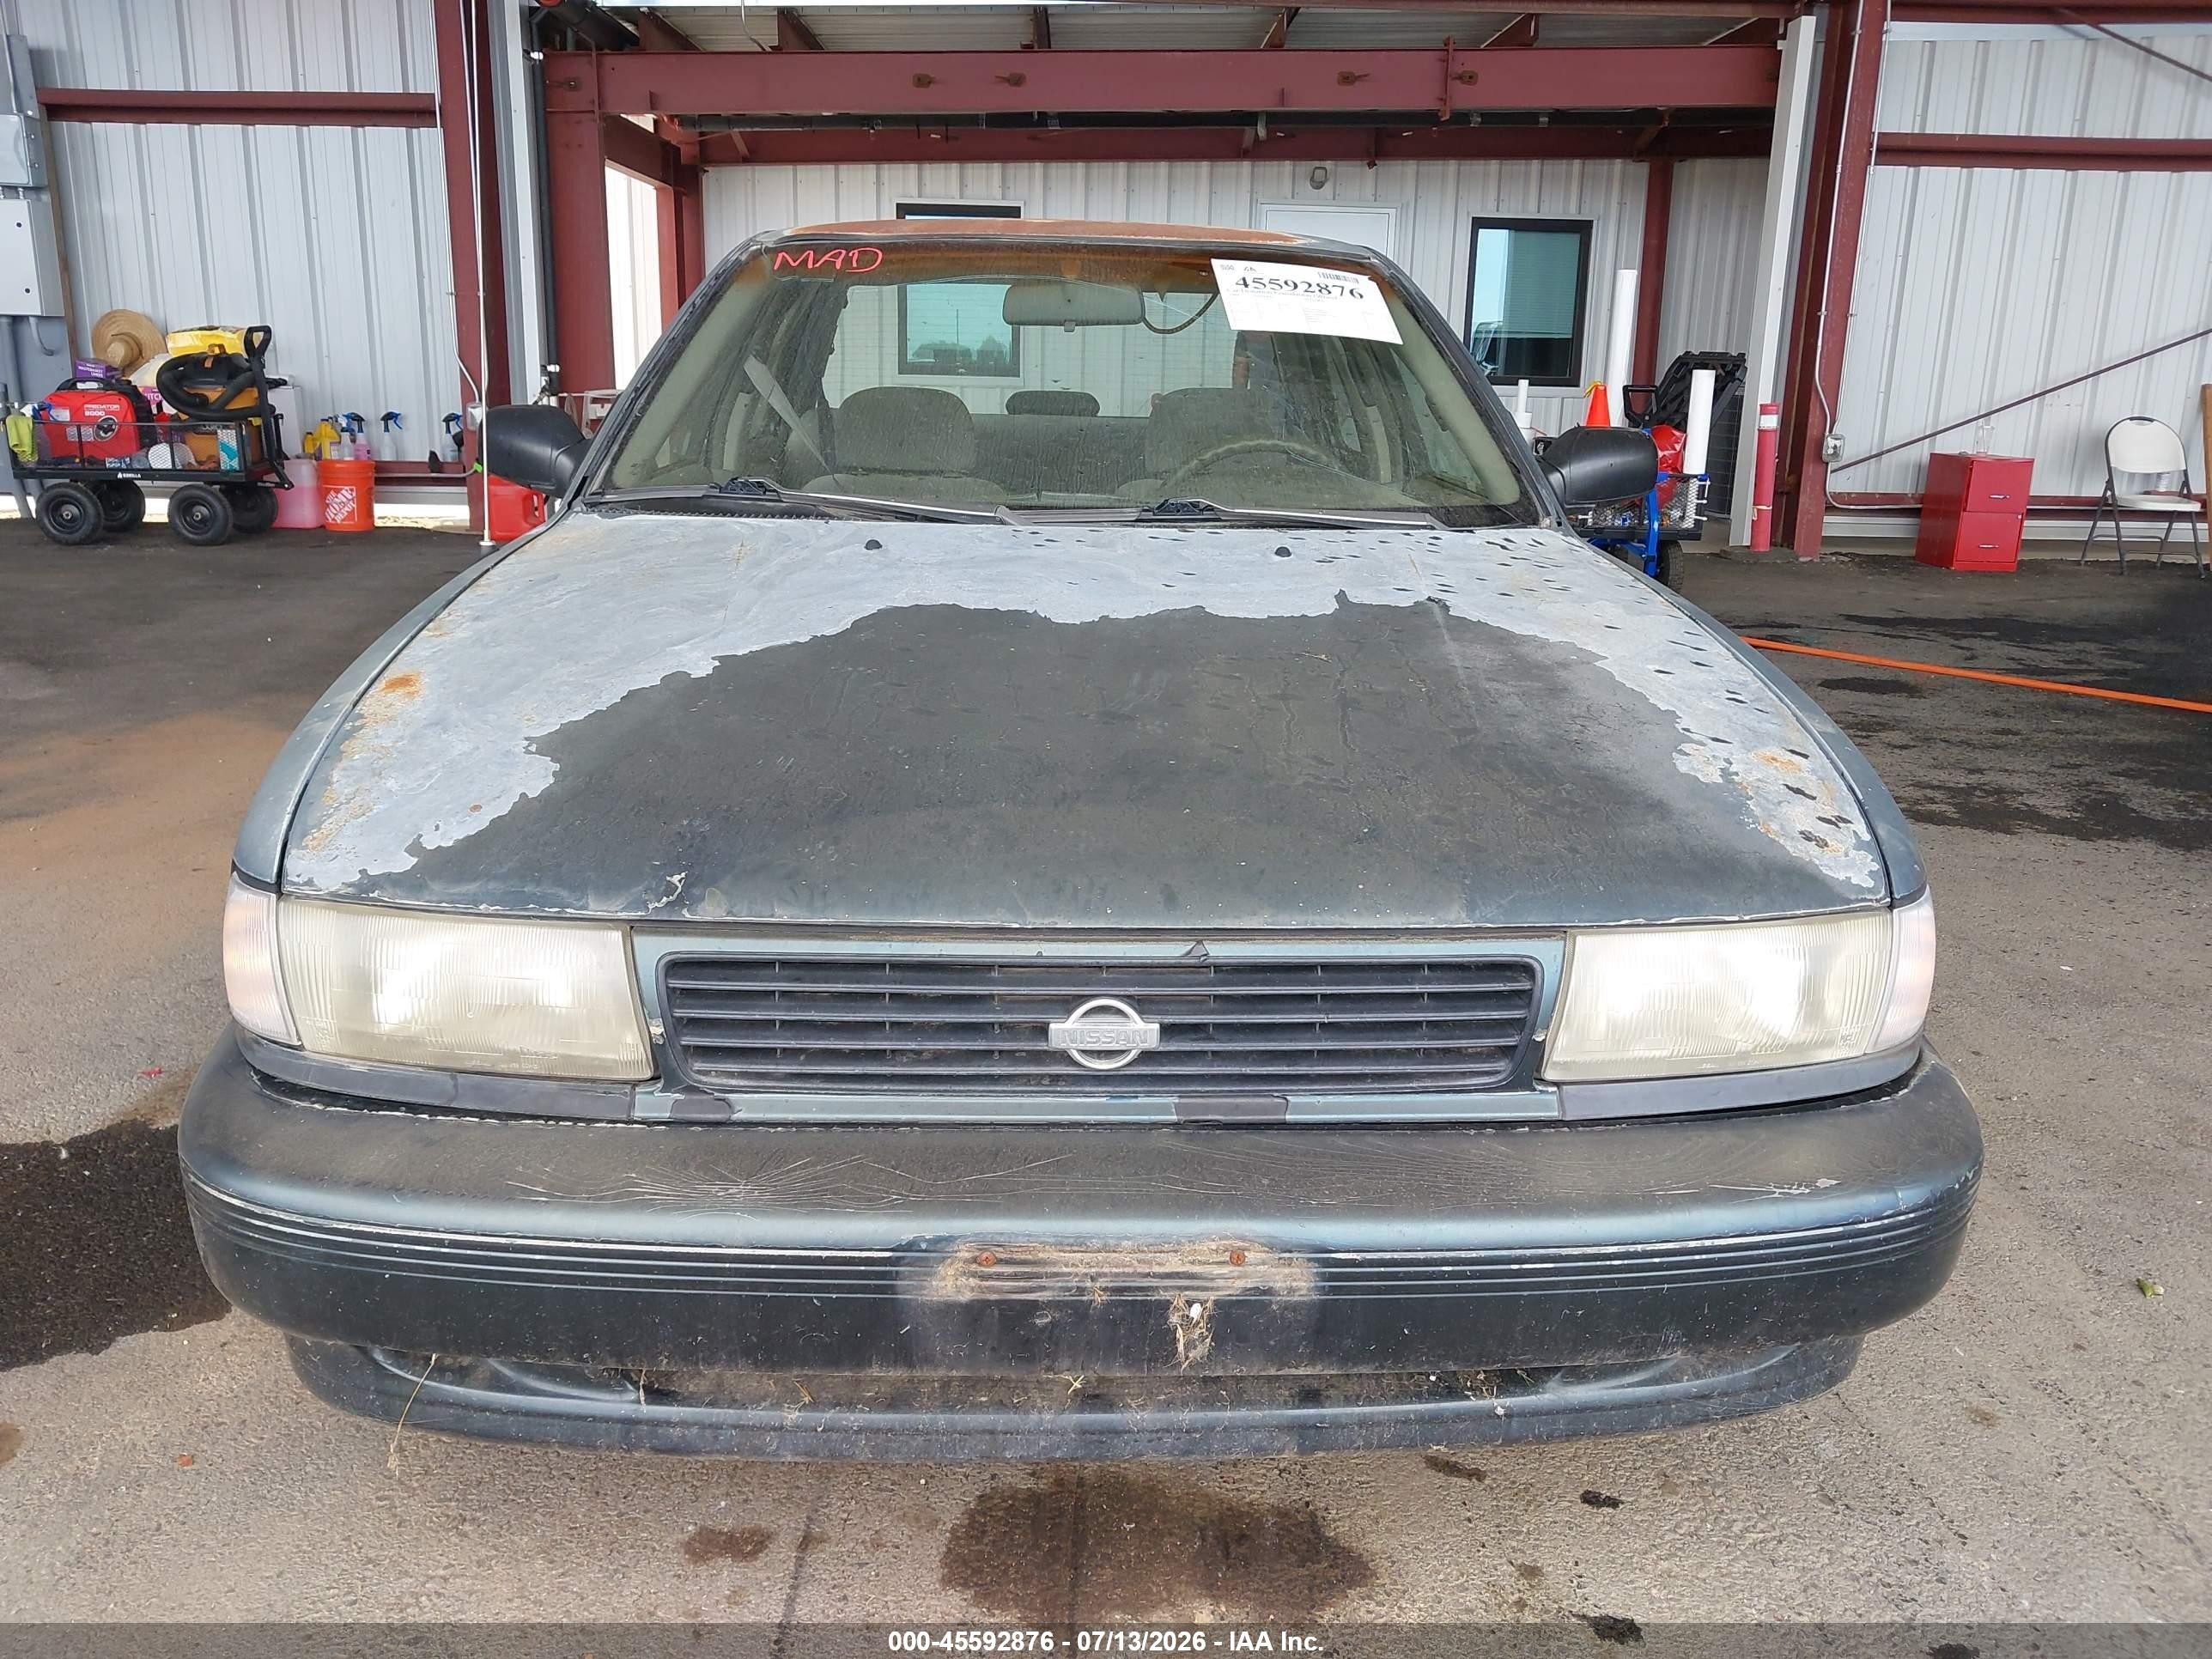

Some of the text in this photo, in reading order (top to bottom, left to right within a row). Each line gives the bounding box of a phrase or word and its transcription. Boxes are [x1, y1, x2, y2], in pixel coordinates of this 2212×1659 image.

[774, 247, 883, 274] MAD
[1235, 276, 1364, 300] 45592876
[325, 487, 354, 523] HOME
[1060, 1030, 1148, 1048] NISSAN
